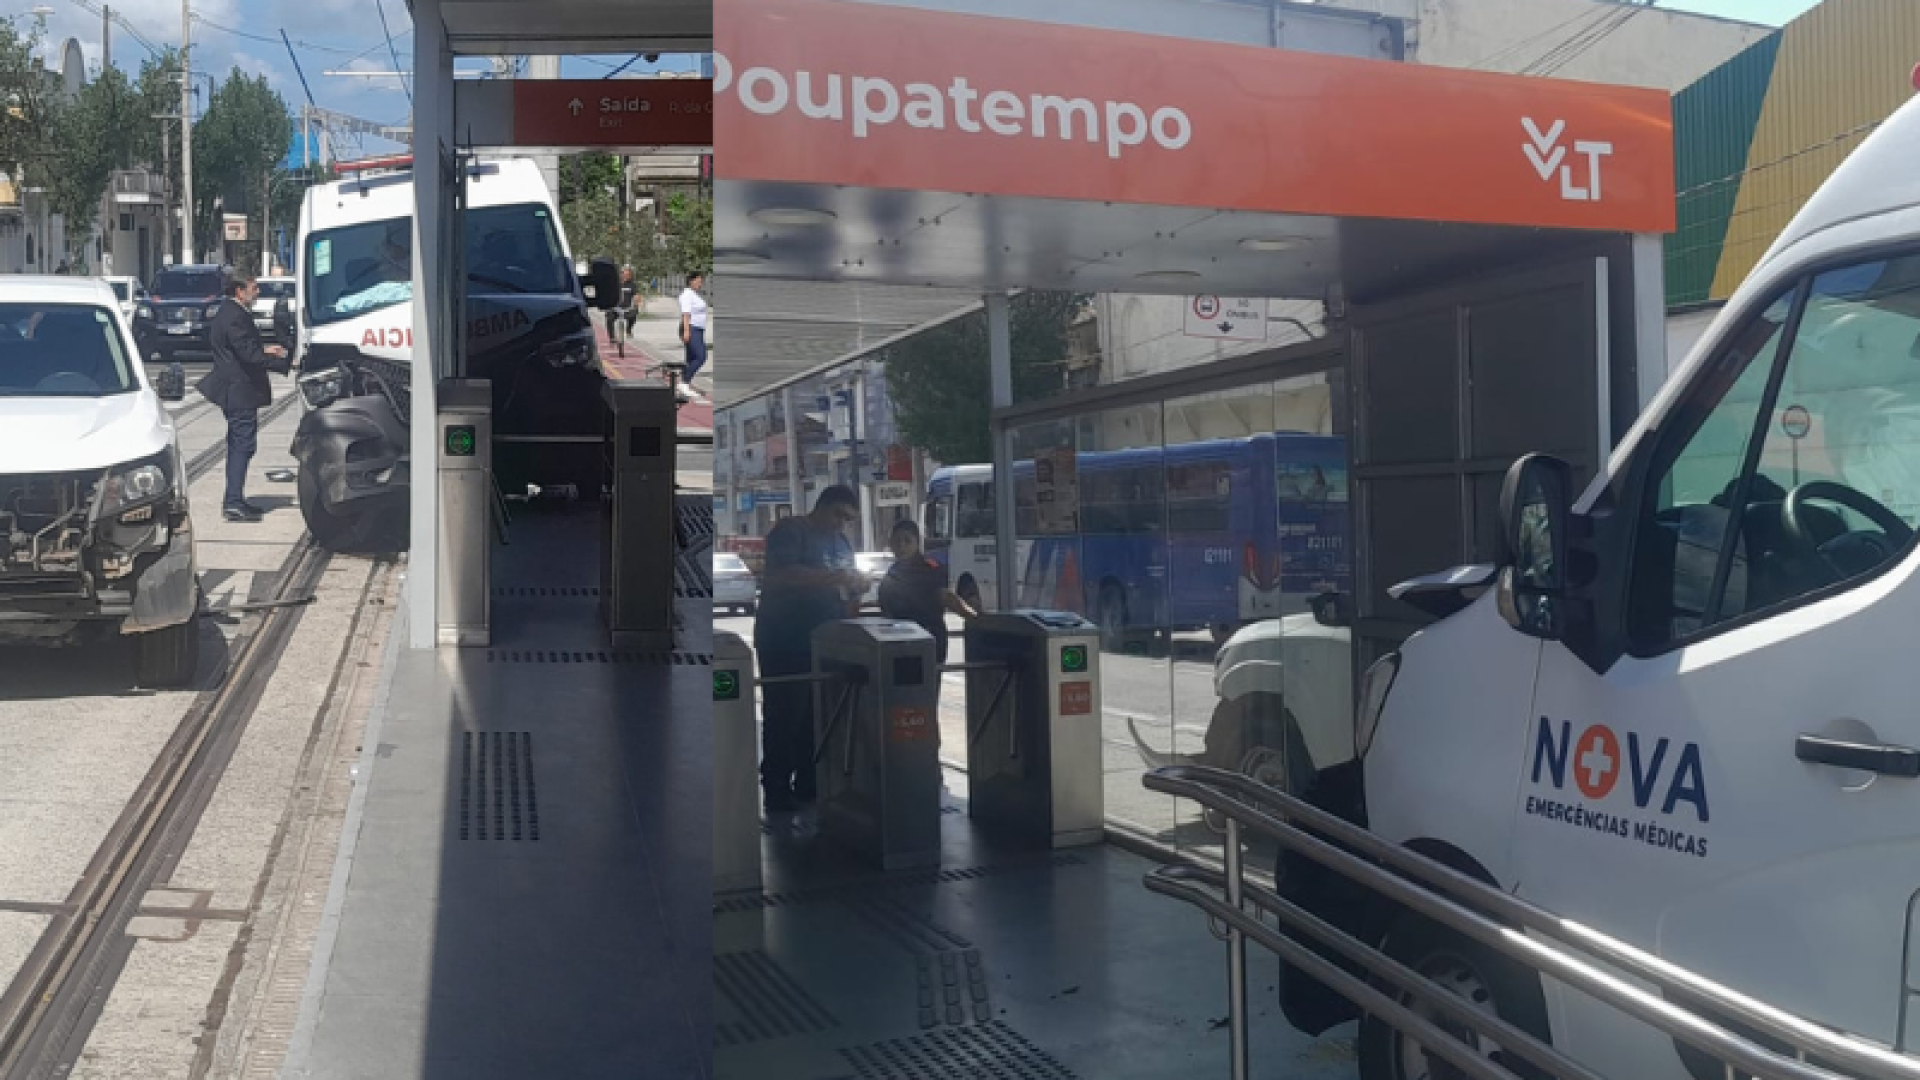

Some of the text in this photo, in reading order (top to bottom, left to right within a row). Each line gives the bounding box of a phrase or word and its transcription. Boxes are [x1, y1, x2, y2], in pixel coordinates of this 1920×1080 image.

[1531, 714, 1710, 823] NOVA
[1526, 795, 1708, 858] EMERGÊNCIAS MÉDICAS
